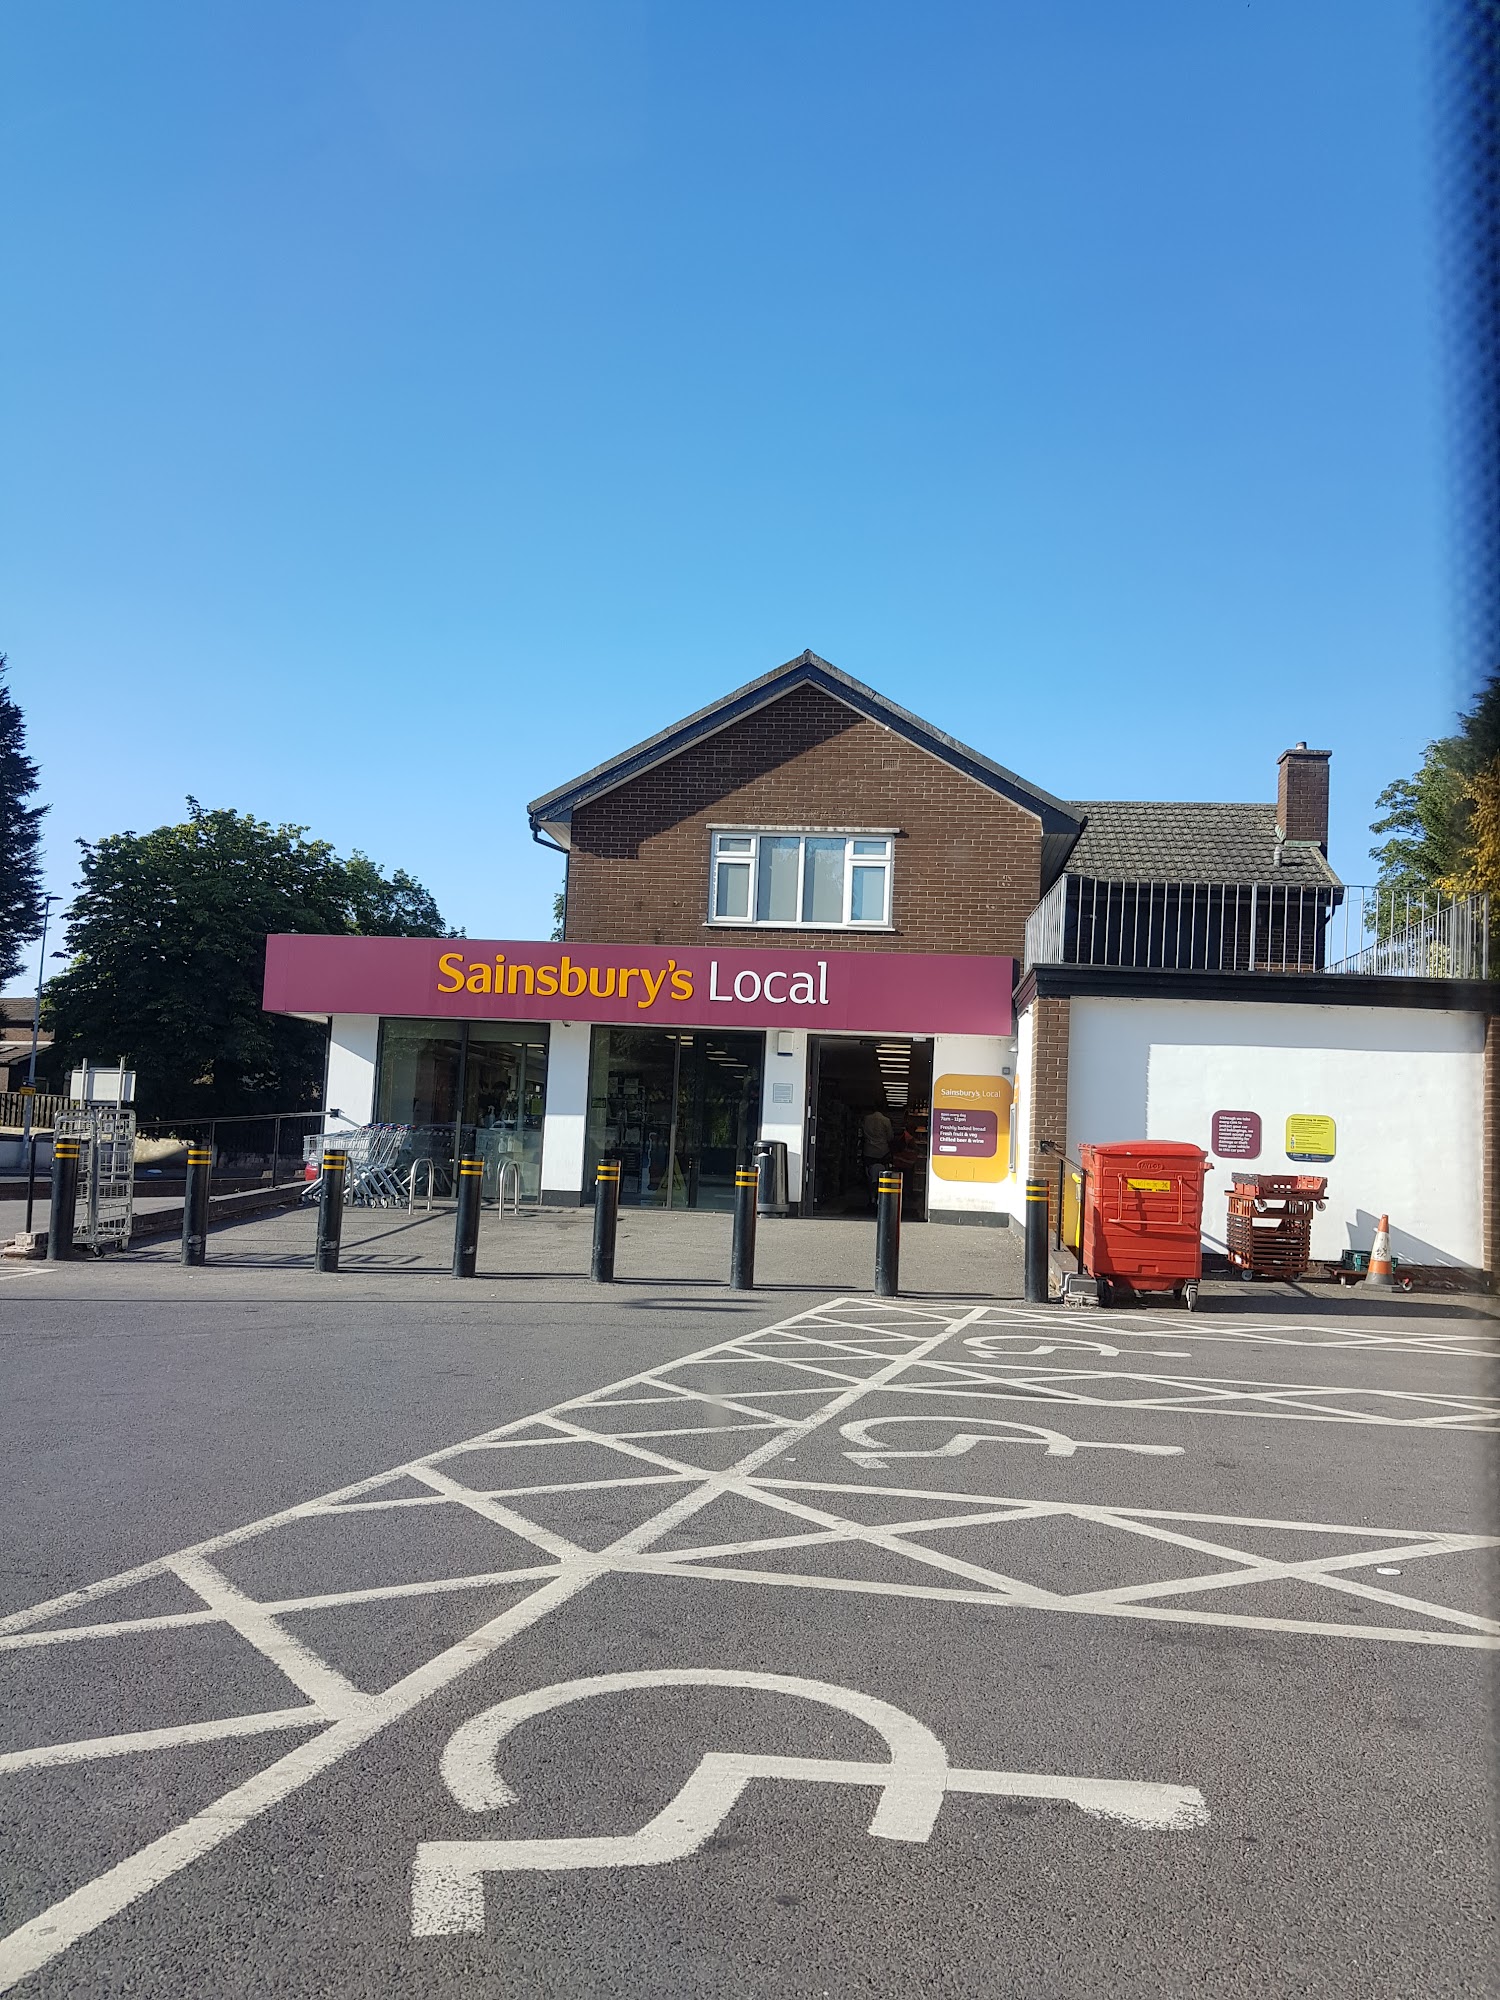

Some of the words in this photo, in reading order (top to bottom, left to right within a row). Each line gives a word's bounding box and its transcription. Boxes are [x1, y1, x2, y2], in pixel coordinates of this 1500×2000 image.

[437, 953, 694, 1008] Sainsbury's
[709, 960, 830, 1005] Local
[941, 1088, 980, 1098] Sainsbury's
